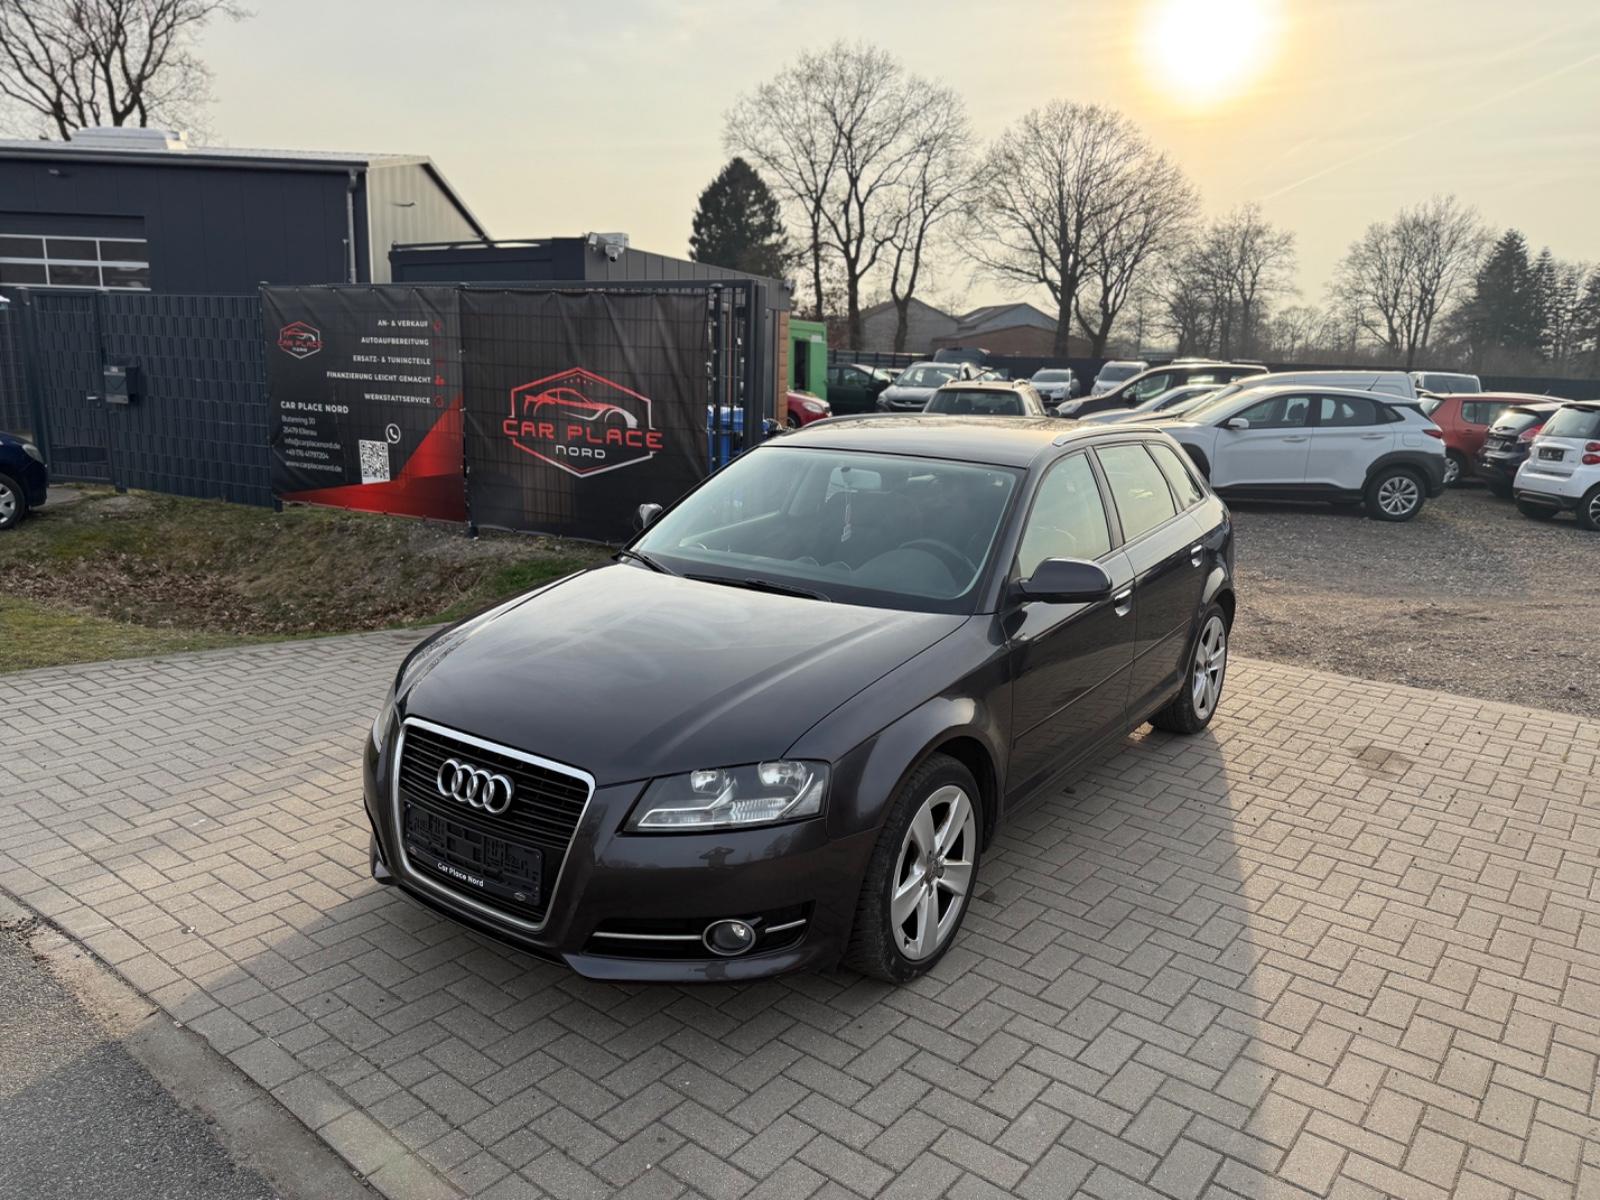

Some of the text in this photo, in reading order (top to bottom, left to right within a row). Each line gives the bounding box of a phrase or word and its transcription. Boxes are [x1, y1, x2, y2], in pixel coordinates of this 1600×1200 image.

[397, 320, 429, 328] VERKAUF
[361, 336, 429, 346] AUTOAUFBEREITUNG
[352, 354, 380, 363] ERSATZ-
[387, 356, 431, 365] TUNINGTEILE
[326, 371, 431, 384] FINANZIERUNG LEICHT GEMACHT
[364, 392, 431, 404] WERKSTATTSERVICE
[280, 400, 349, 414] CAR PLACE NORD
[503, 418, 663, 448] CAR PLACE
[437, 862, 483, 887] Car Place Nord
